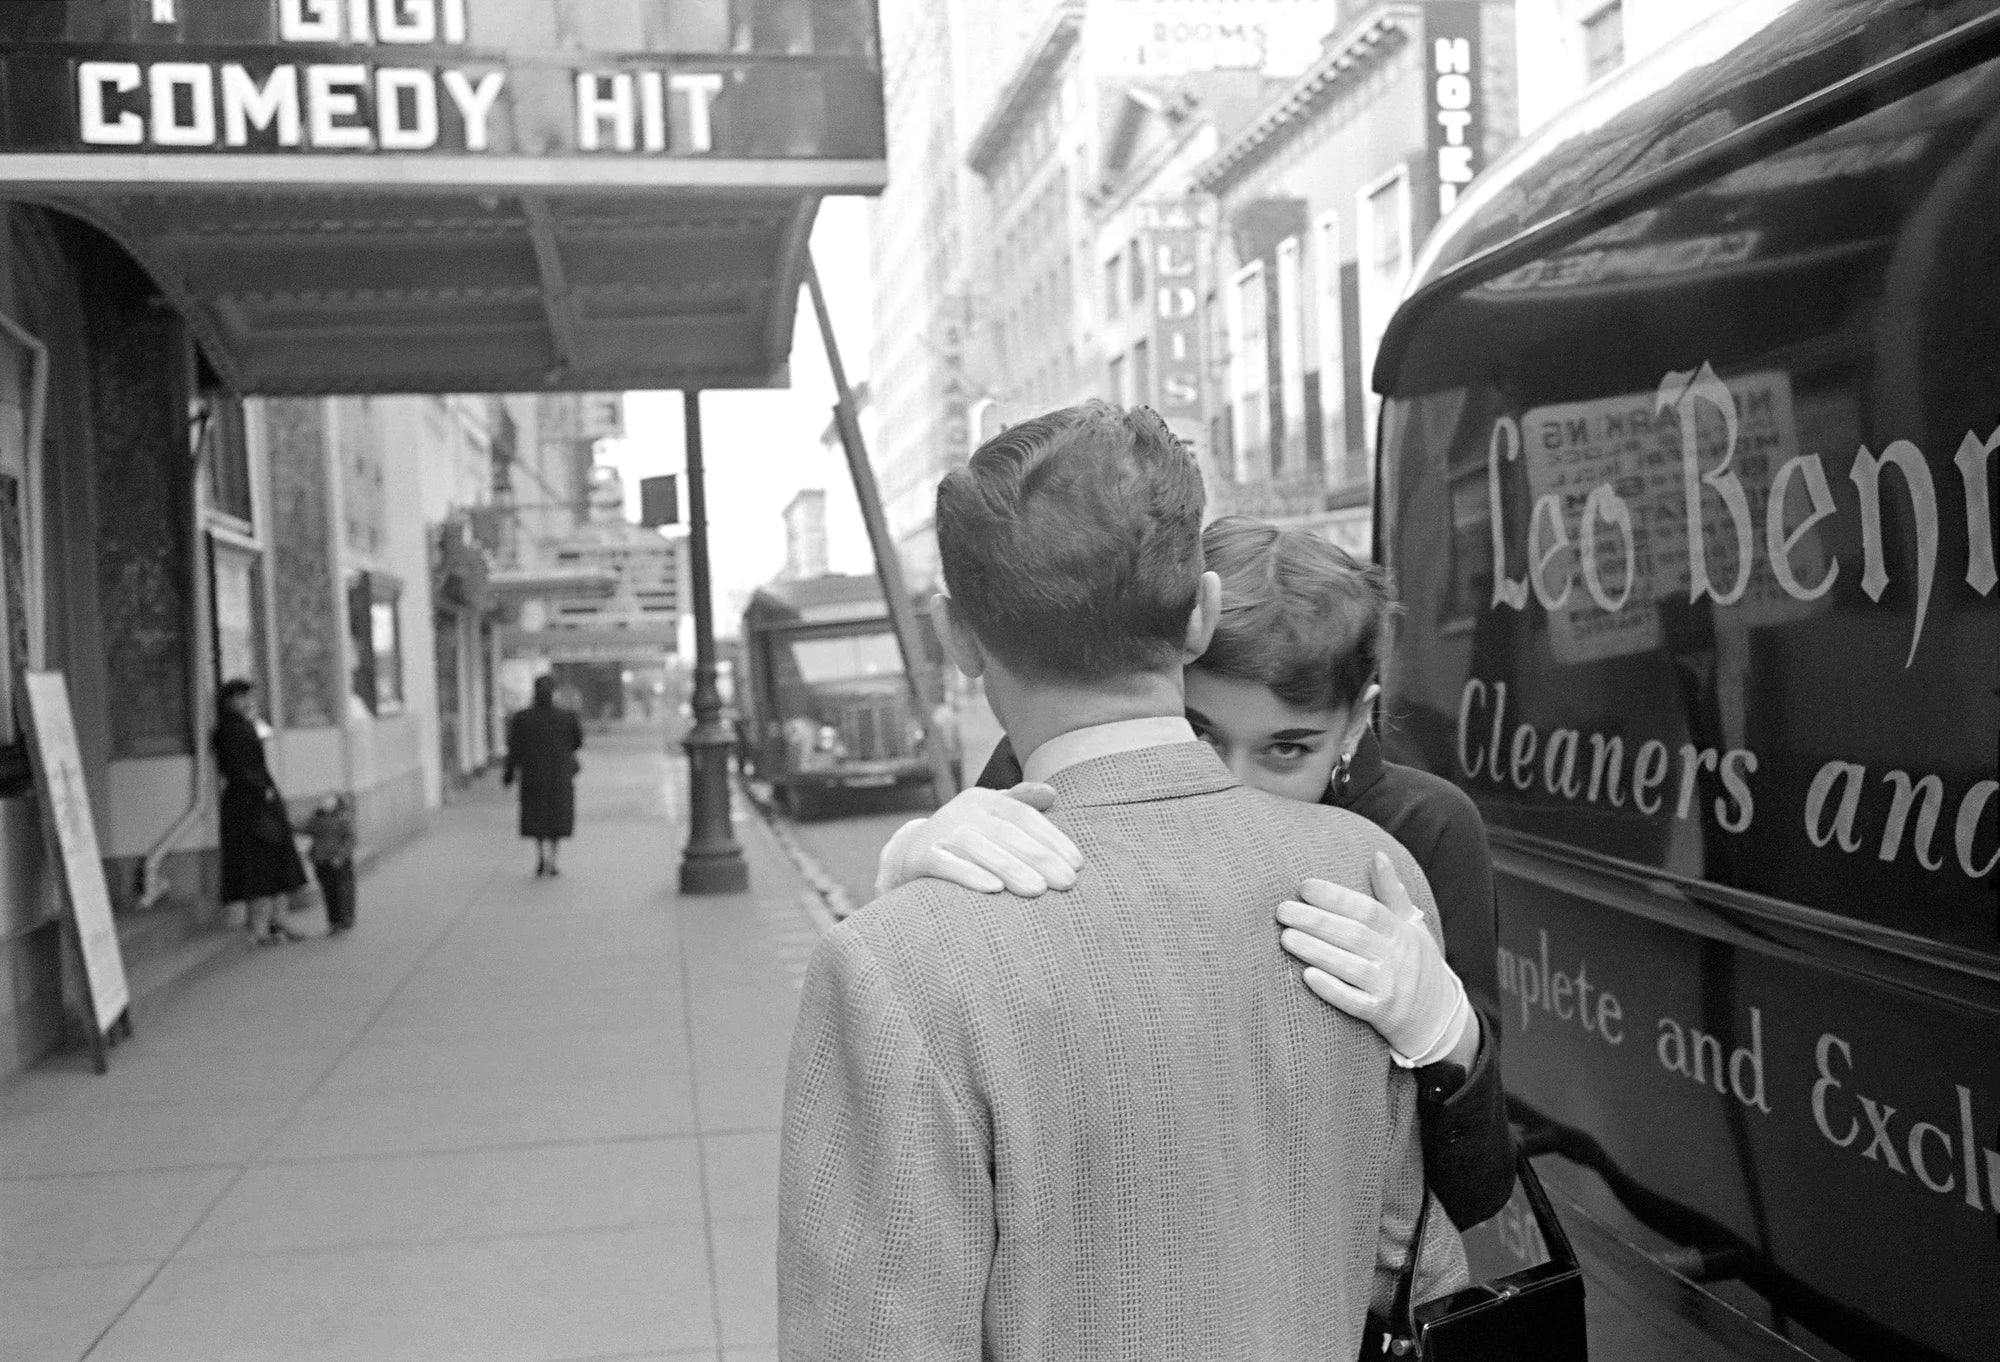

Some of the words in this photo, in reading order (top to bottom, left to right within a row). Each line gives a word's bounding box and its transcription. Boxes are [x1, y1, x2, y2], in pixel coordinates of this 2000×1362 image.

[79, 62, 505, 151] COMEDY
[577, 71, 723, 152] HIT
[1488, 415, 1634, 612] Leo
[1457, 678, 1758, 834] Cleaners
[1656, 1007, 1771, 1114] and
